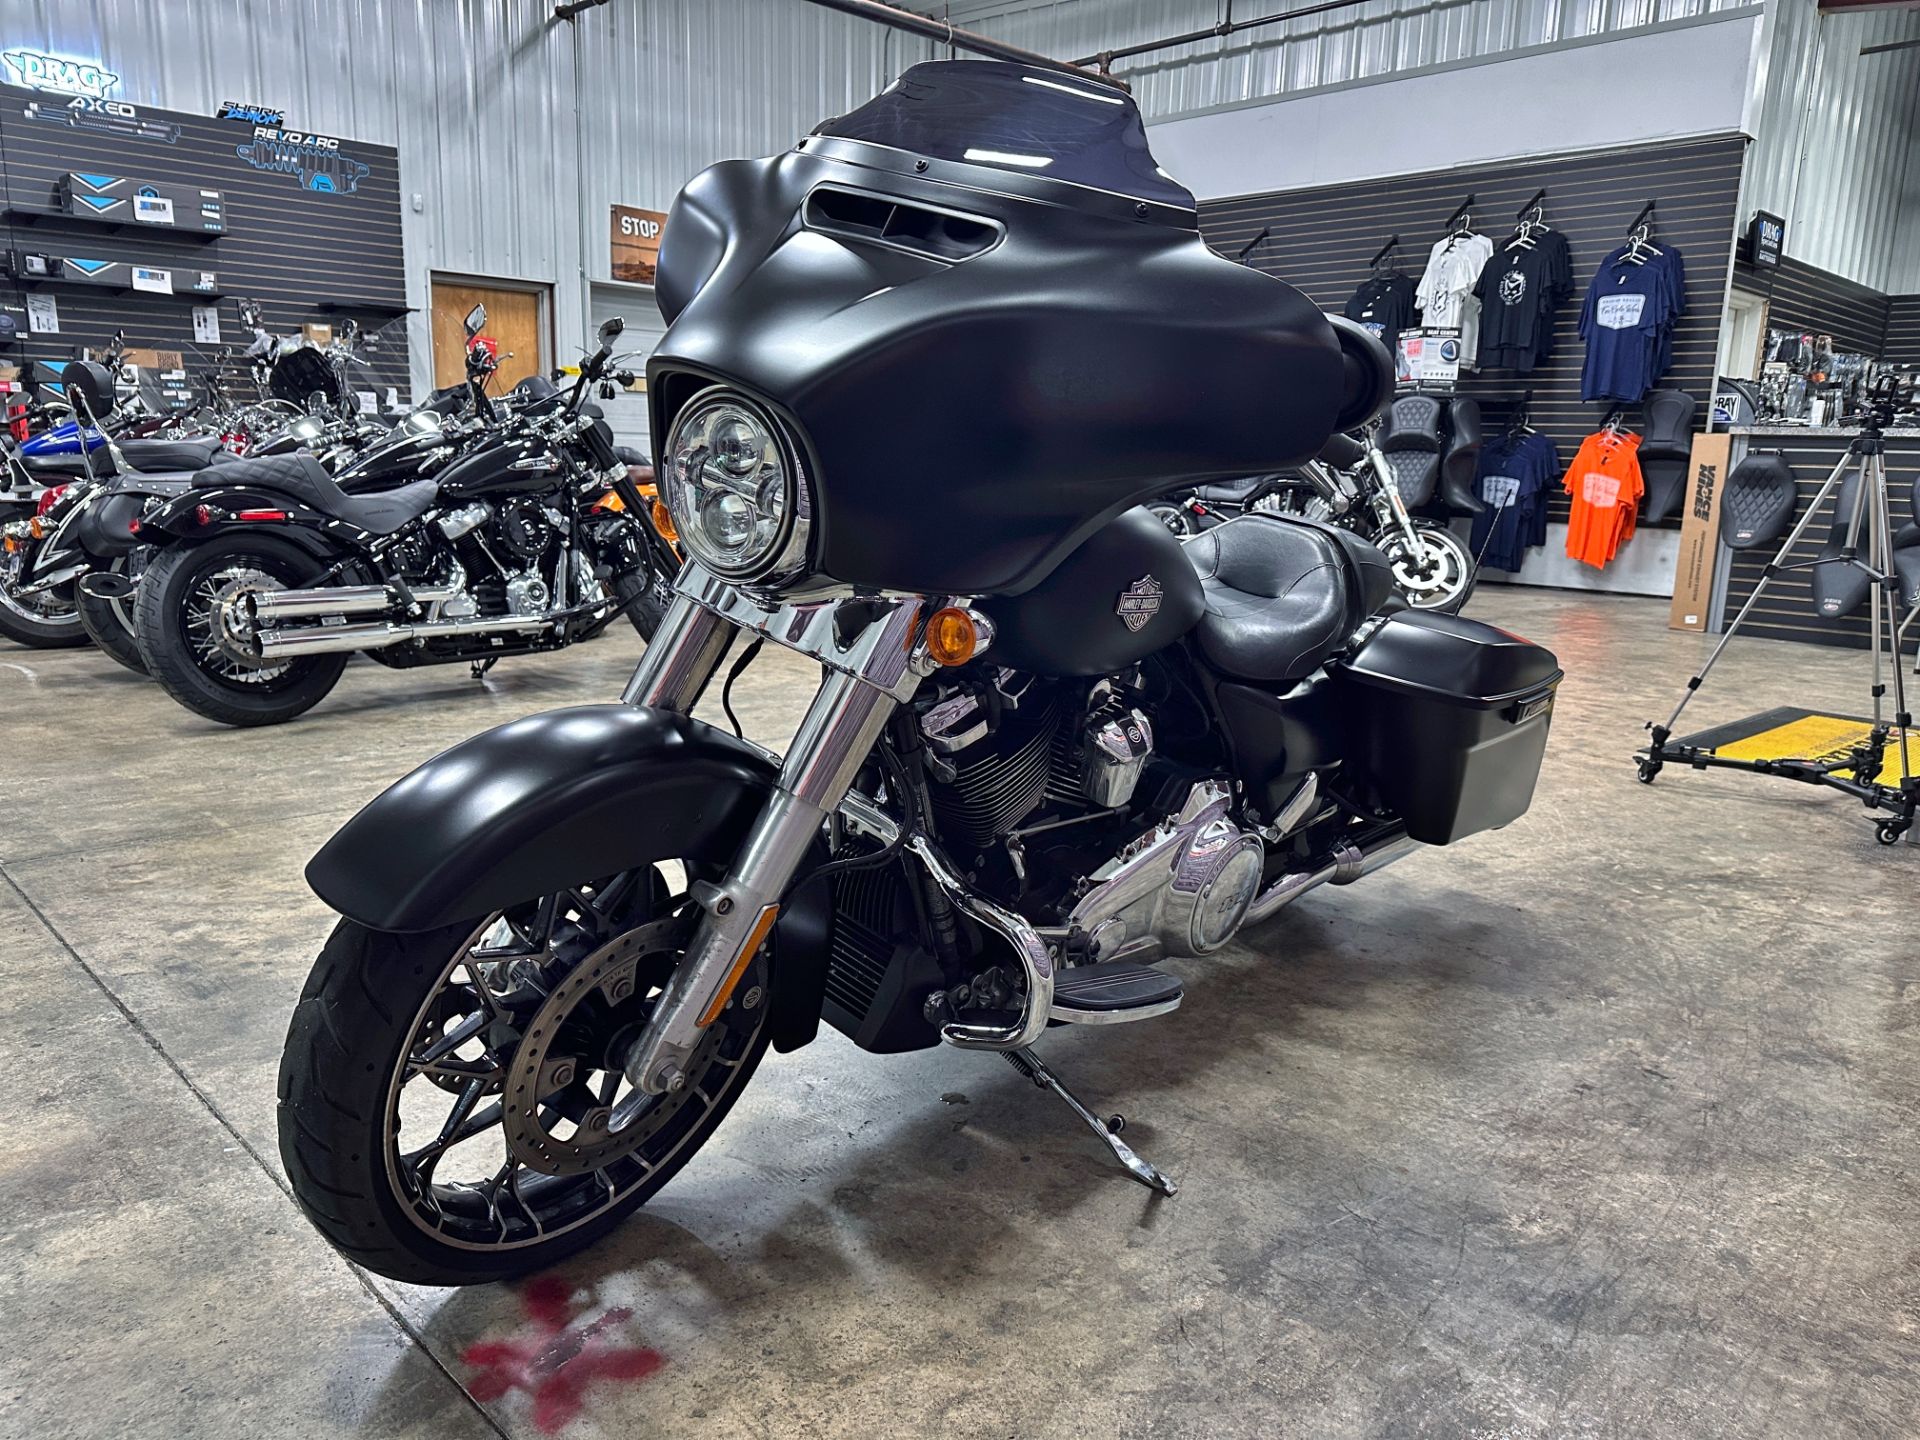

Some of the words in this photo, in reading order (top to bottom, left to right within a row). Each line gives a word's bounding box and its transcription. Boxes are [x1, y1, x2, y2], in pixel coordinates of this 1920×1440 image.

[22, 53, 101, 89] DRAG
[621, 215, 660, 239] STOP
[1715, 396, 1738, 418] RAY
[1694, 464, 1709, 519] HINES
[1701, 465, 1716, 521] VANCE
[1137, 583, 1156, 595] MOTOR
